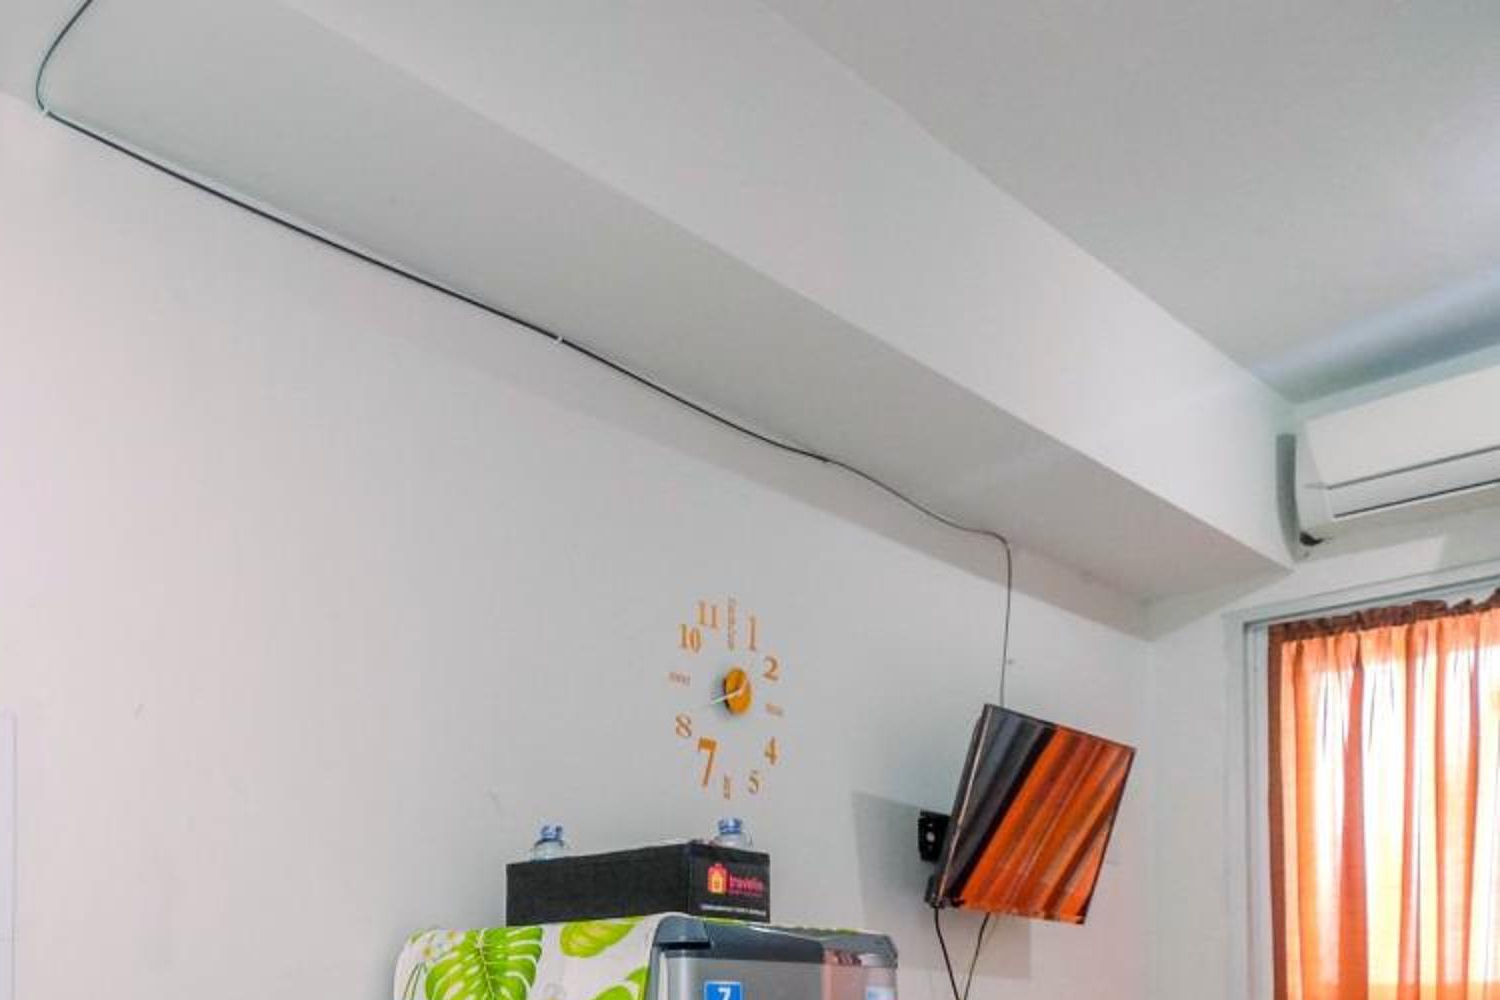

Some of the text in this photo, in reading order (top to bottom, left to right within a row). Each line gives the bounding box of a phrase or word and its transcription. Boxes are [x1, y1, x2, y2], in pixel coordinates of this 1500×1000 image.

[698, 600, 719, 630] 11
[680, 623, 701, 652] 10
[748, 615, 757, 651] 1
[763, 656, 778, 681] 2
[675, 713, 692, 737] 8
[698, 736, 717, 787] 7
[764, 736, 777, 766] 4
